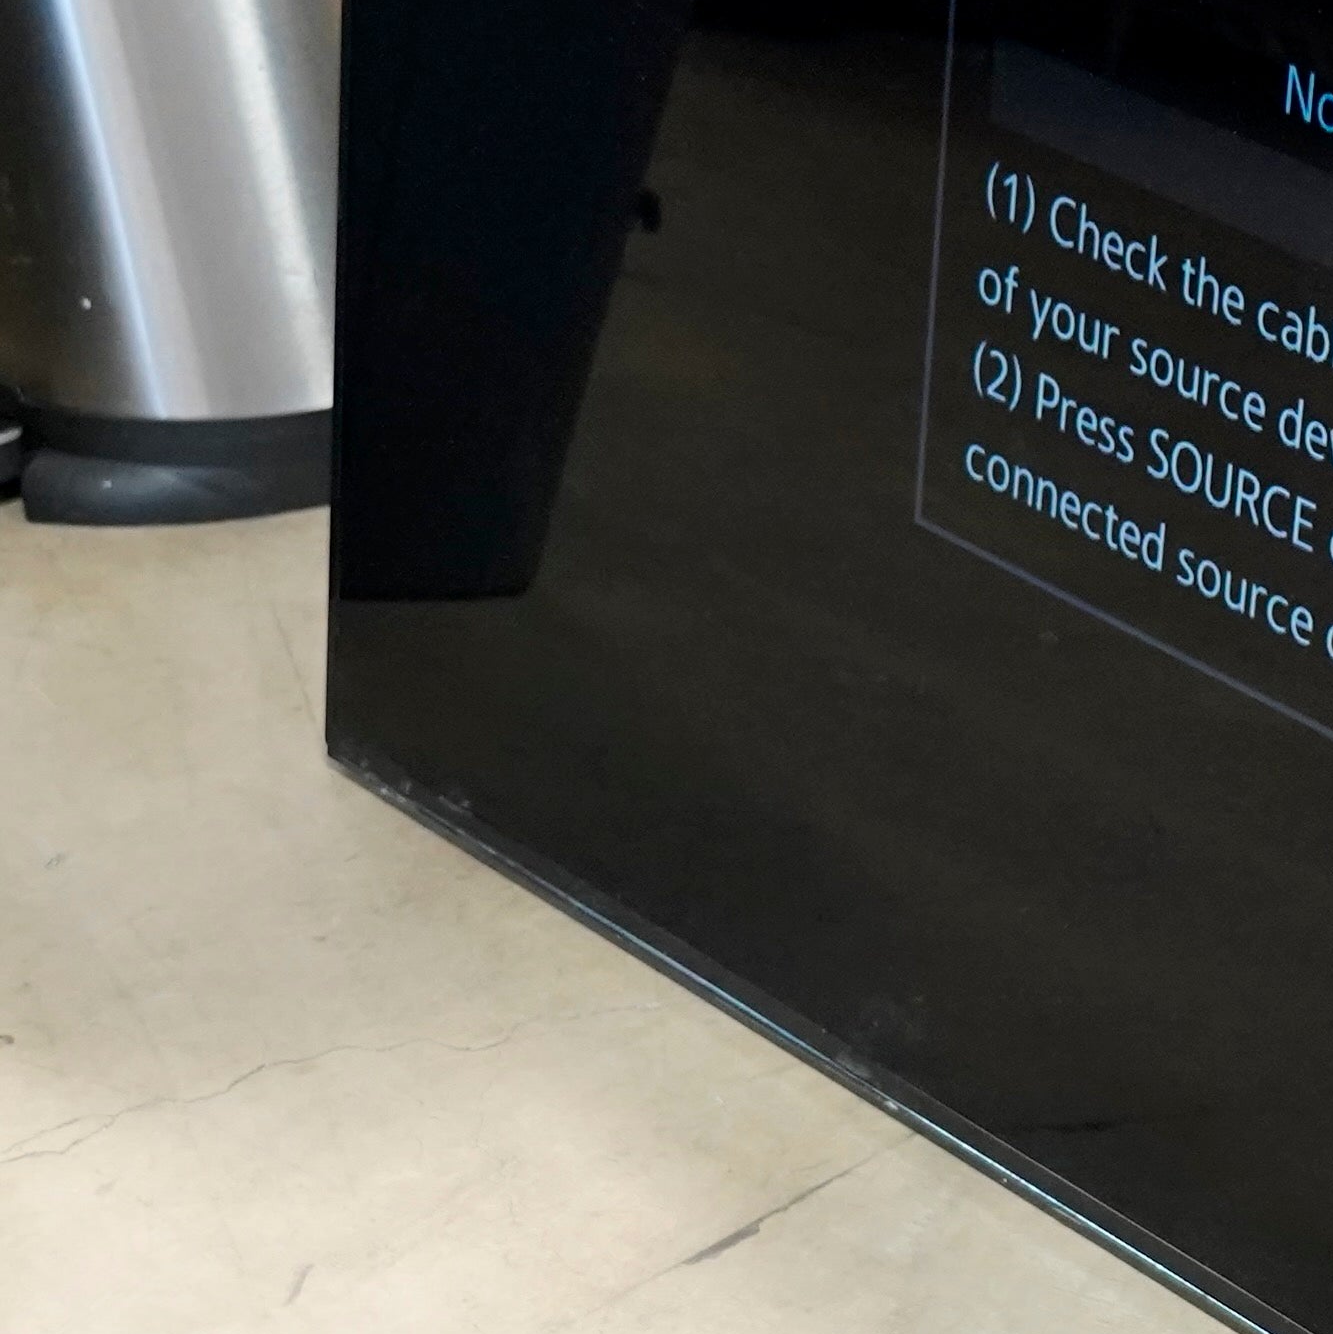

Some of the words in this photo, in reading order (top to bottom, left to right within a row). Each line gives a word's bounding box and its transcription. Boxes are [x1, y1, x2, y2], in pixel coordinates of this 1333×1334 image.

[987, 162, 1035, 233] (1)
[1050, 196, 1168, 291] Check
[1182, 256, 1245, 325] the
[978, 265, 1019, 313] of
[1030, 289, 1120, 359] your
[1129, 338, 1266, 432] source
[973, 341, 1022, 411] (2)
[1036, 372, 1134, 463] Press
[1146, 428, 1317, 552] SOURCE
[965, 444, 1166, 572] connected
[1176, 548, 1314, 646] source
